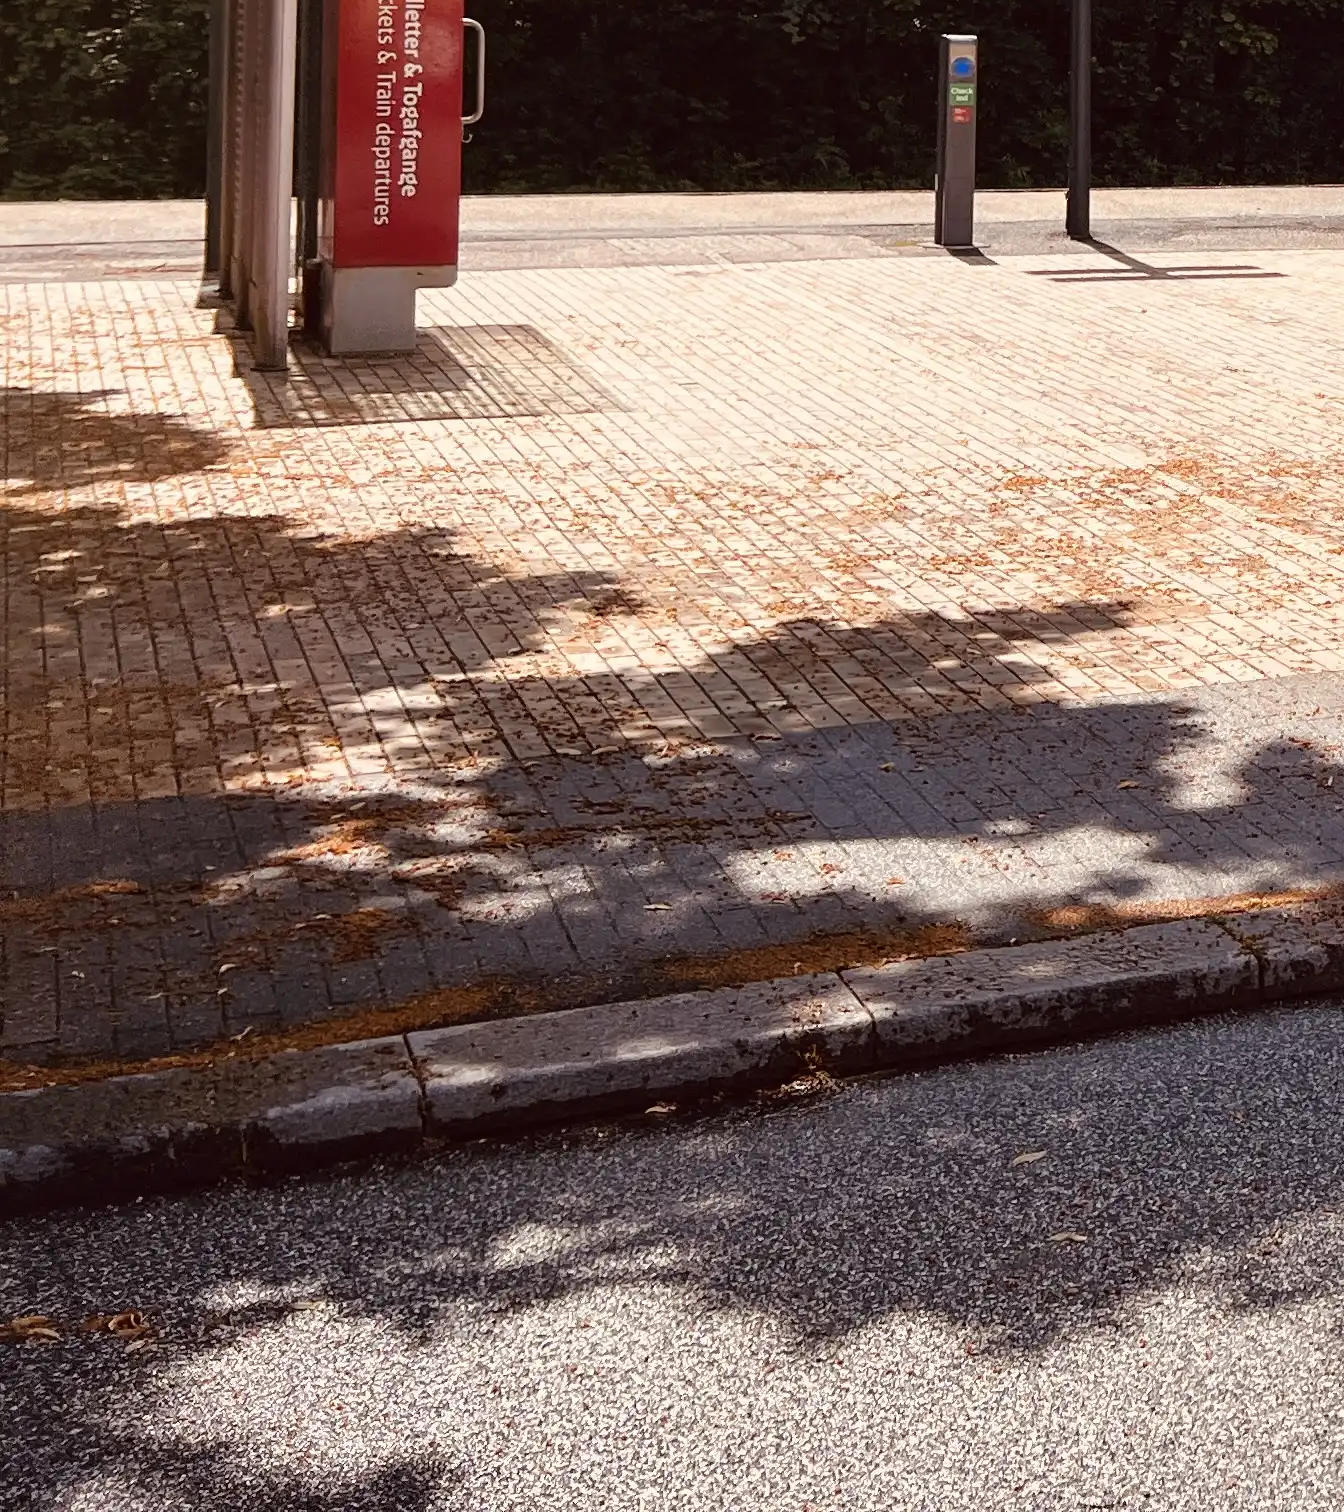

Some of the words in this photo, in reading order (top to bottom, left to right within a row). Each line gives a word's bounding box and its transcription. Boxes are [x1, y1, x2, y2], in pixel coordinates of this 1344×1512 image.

[377, 50, 397, 65] &
[403, 63, 423, 78] &
[375, 71, 397, 117] Train
[397, 82, 423, 197] Togafgange
[371, 122, 396, 225] departures
